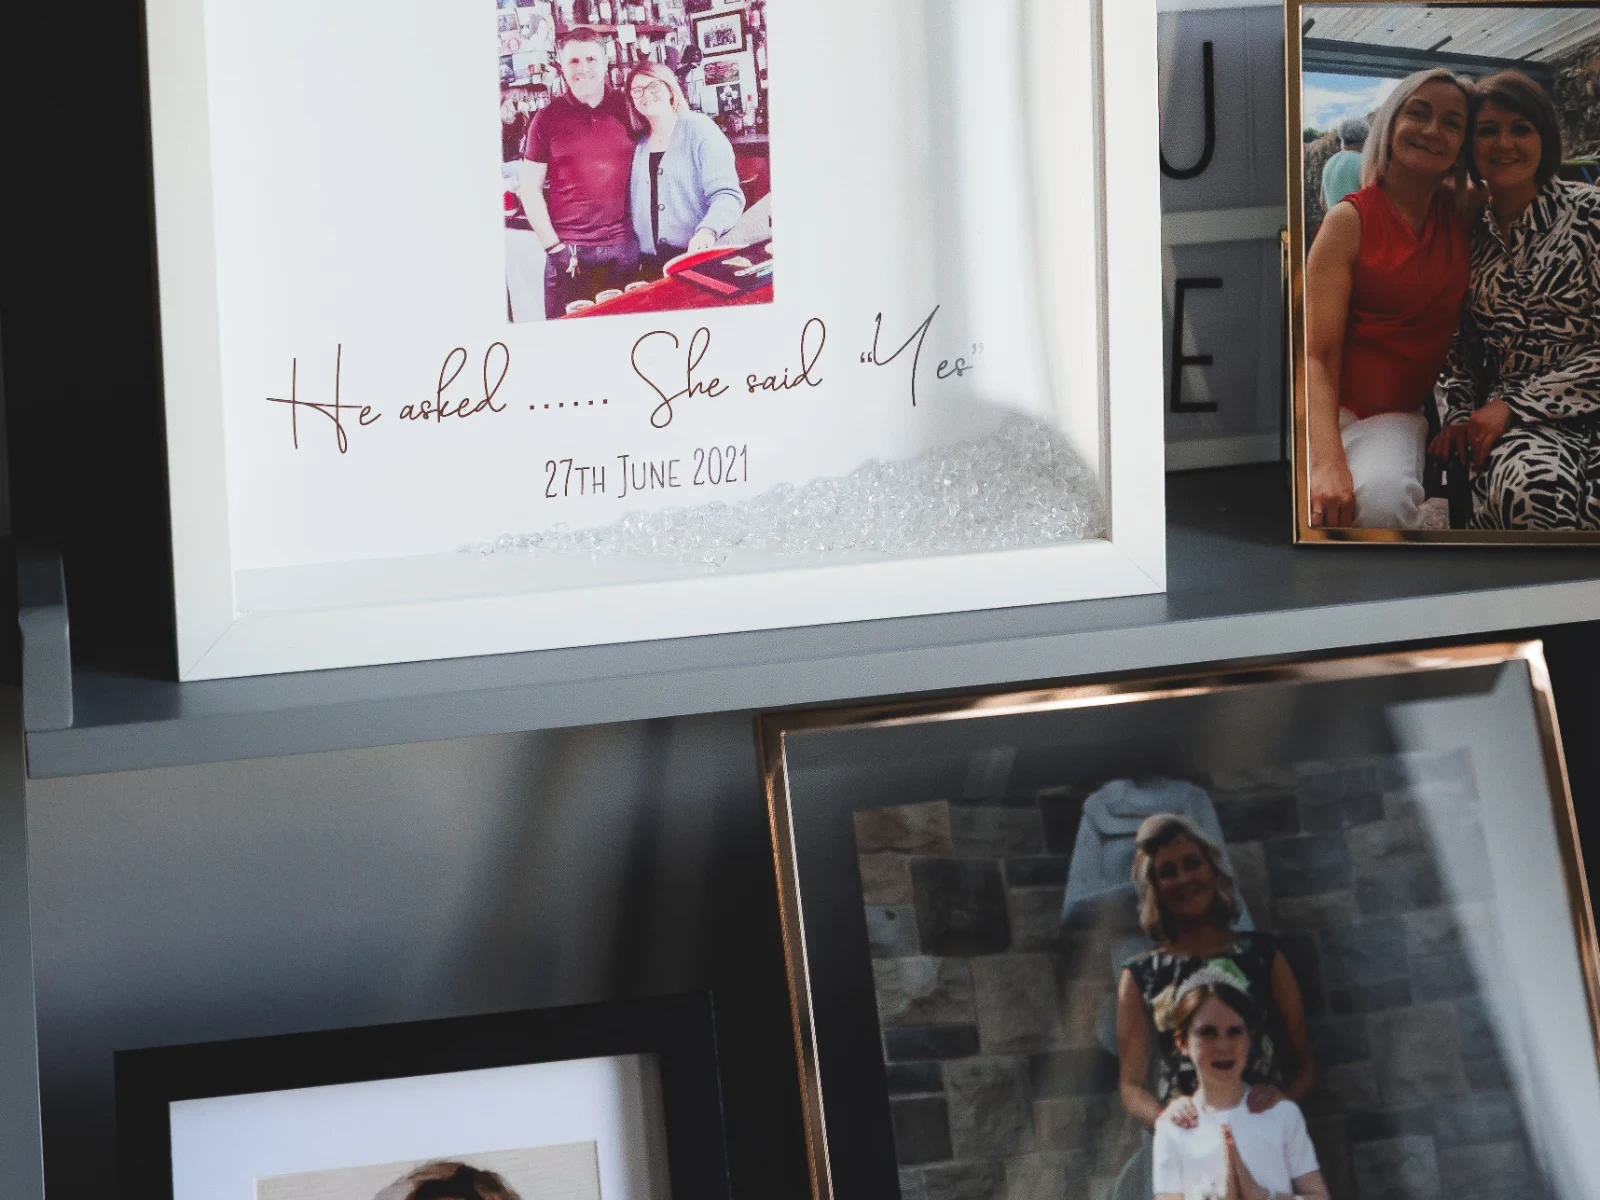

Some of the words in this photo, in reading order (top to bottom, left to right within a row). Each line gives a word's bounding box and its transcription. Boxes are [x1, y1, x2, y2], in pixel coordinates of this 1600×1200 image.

[266, 343, 382, 454] He
[399, 341, 510, 423] asked
[631, 326, 730, 429] She
[747, 317, 827, 393] said
[1170, 277, 1223, 414] E
[692, 443, 750, 486] 2021
